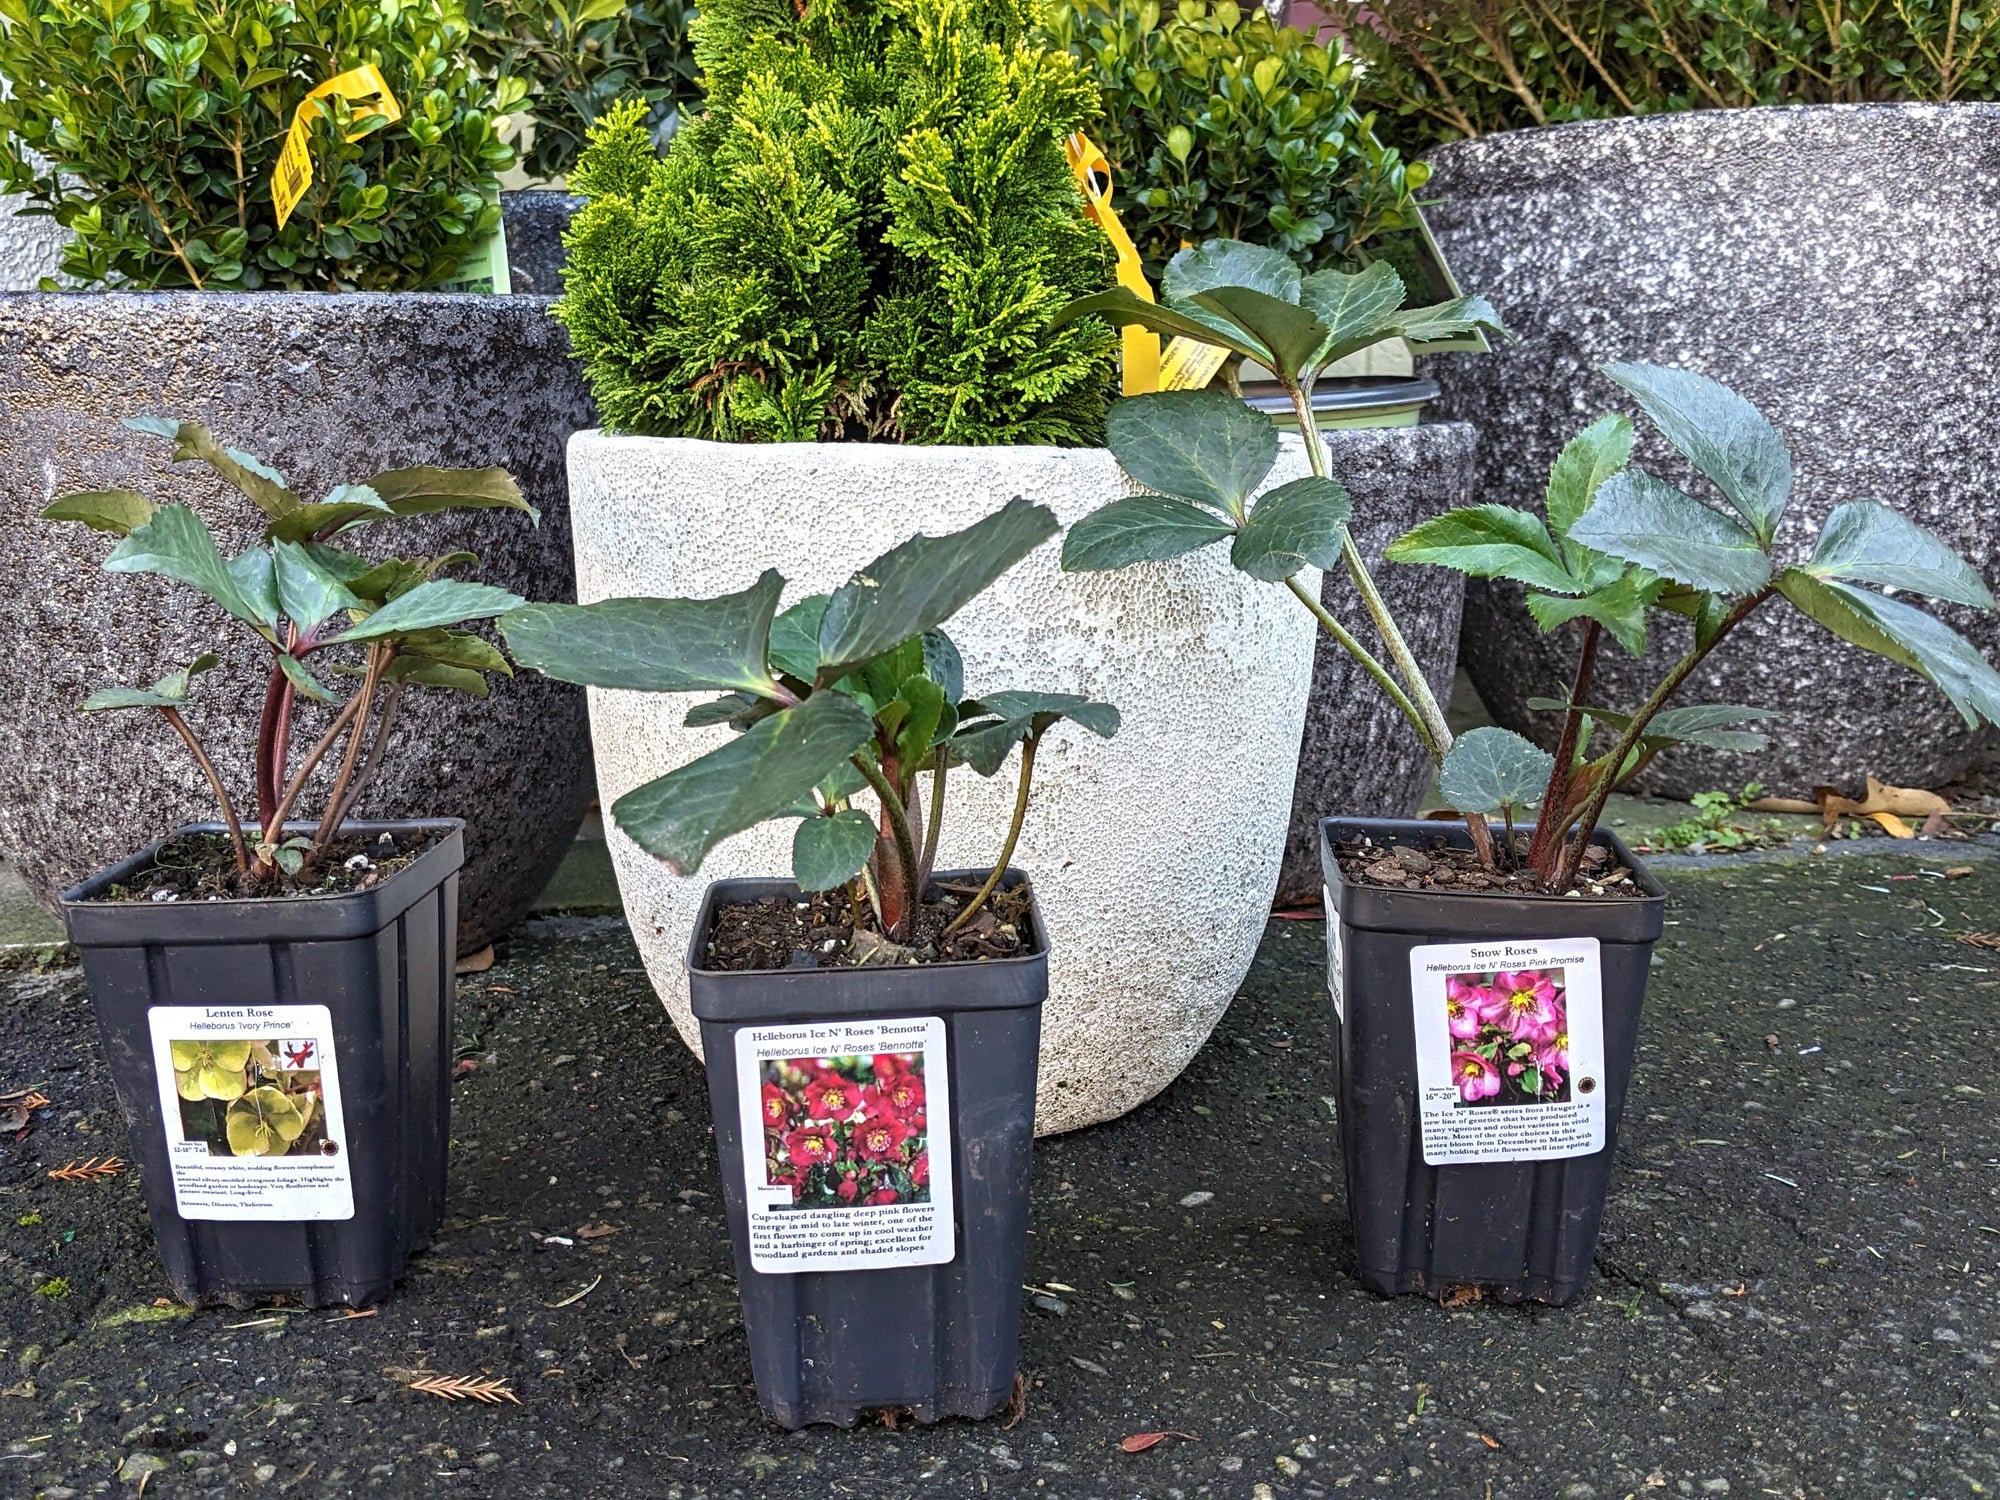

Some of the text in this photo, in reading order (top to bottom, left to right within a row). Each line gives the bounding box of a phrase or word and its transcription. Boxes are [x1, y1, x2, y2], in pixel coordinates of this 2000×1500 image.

[1471, 947, 1537, 958] Snow Roses
[1427, 963, 1470, 972] Helleborus
[1529, 958, 1547, 966] Pink
[1550, 956, 1584, 965] Promise
[206, 1009, 273, 1018] Lenten Rose
[753, 1023, 928, 1041] Helleborus Ice N' Roses 'Bennotta'
[757, 1048, 809, 1057] Helleborus
[813, 1045, 827, 1054] Ice
[844, 1044, 874, 1052] Roses
[878, 1040, 926, 1050] 'Bennotta'
[1546, 1104, 1575, 1113] Heuger
[1469, 1117, 1500, 1125] genetics
[1541, 1112, 1577, 1121] produced
[1567, 1141, 1592, 1150] spring.
[752, 1213, 806, 1222] Cup-shaped
[810, 1211, 850, 1220] dangling
[854, 1210, 876, 1218] deep
[879, 1208, 900, 1217] pink
[753, 1224, 786, 1232] emerge
[853, 1219, 885, 1227] winter,
[850, 1230, 860, 1239] up
[782, 1240, 826, 1249] harbinger
[841, 1239, 872, 1247] spring;
[875, 1235, 916, 1244] excellent
[802, 1250, 838, 1259] gardens
[861, 1246, 893, 1255] shaded
[896, 1244, 924, 1253] slopes
